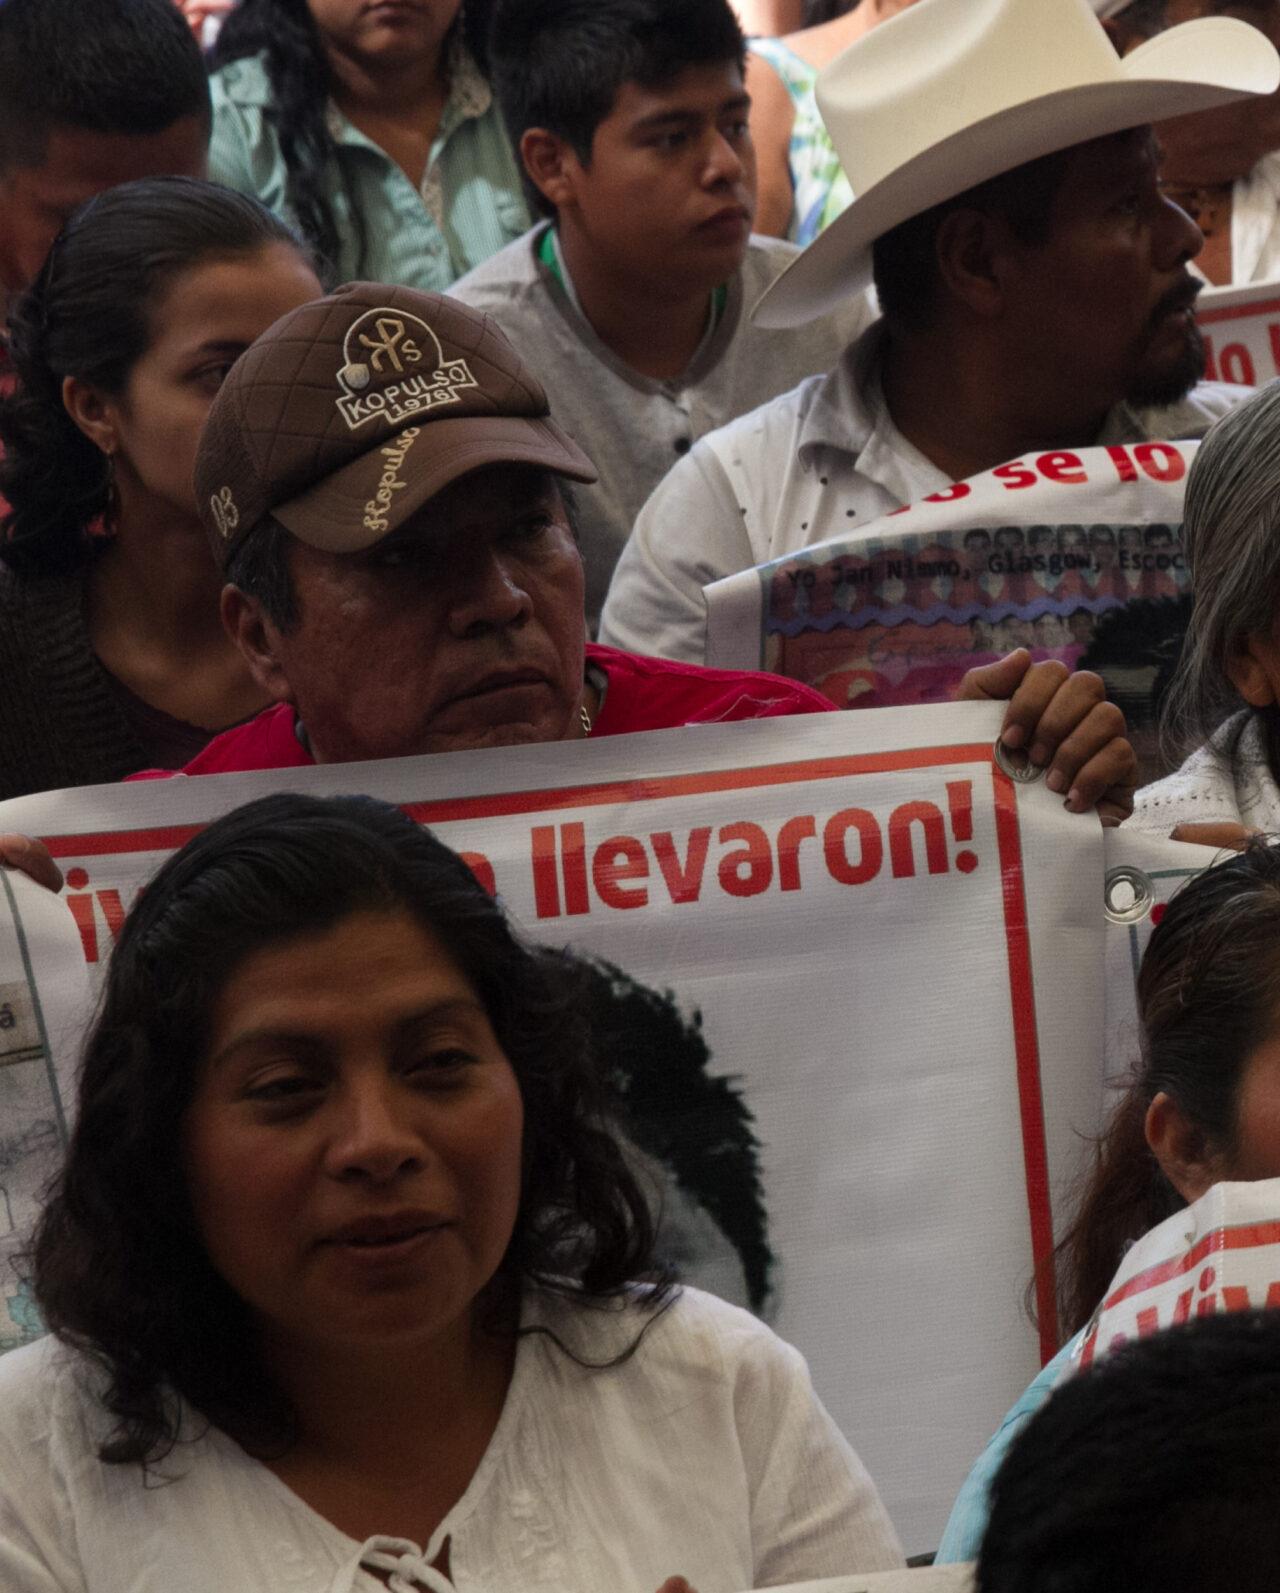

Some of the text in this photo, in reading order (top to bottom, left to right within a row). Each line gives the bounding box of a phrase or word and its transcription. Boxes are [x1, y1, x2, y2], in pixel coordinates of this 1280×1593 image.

[346, 366, 466, 420] KOPULSO
[392, 388, 450, 417] 1976
[992, 443, 1186, 490] se lo
[832, 564, 874, 585] Jan
[988, 550, 1101, 577] Glasgow,
[1119, 552, 1184, 571] Escoc
[531, 779, 978, 918] llevaron!
